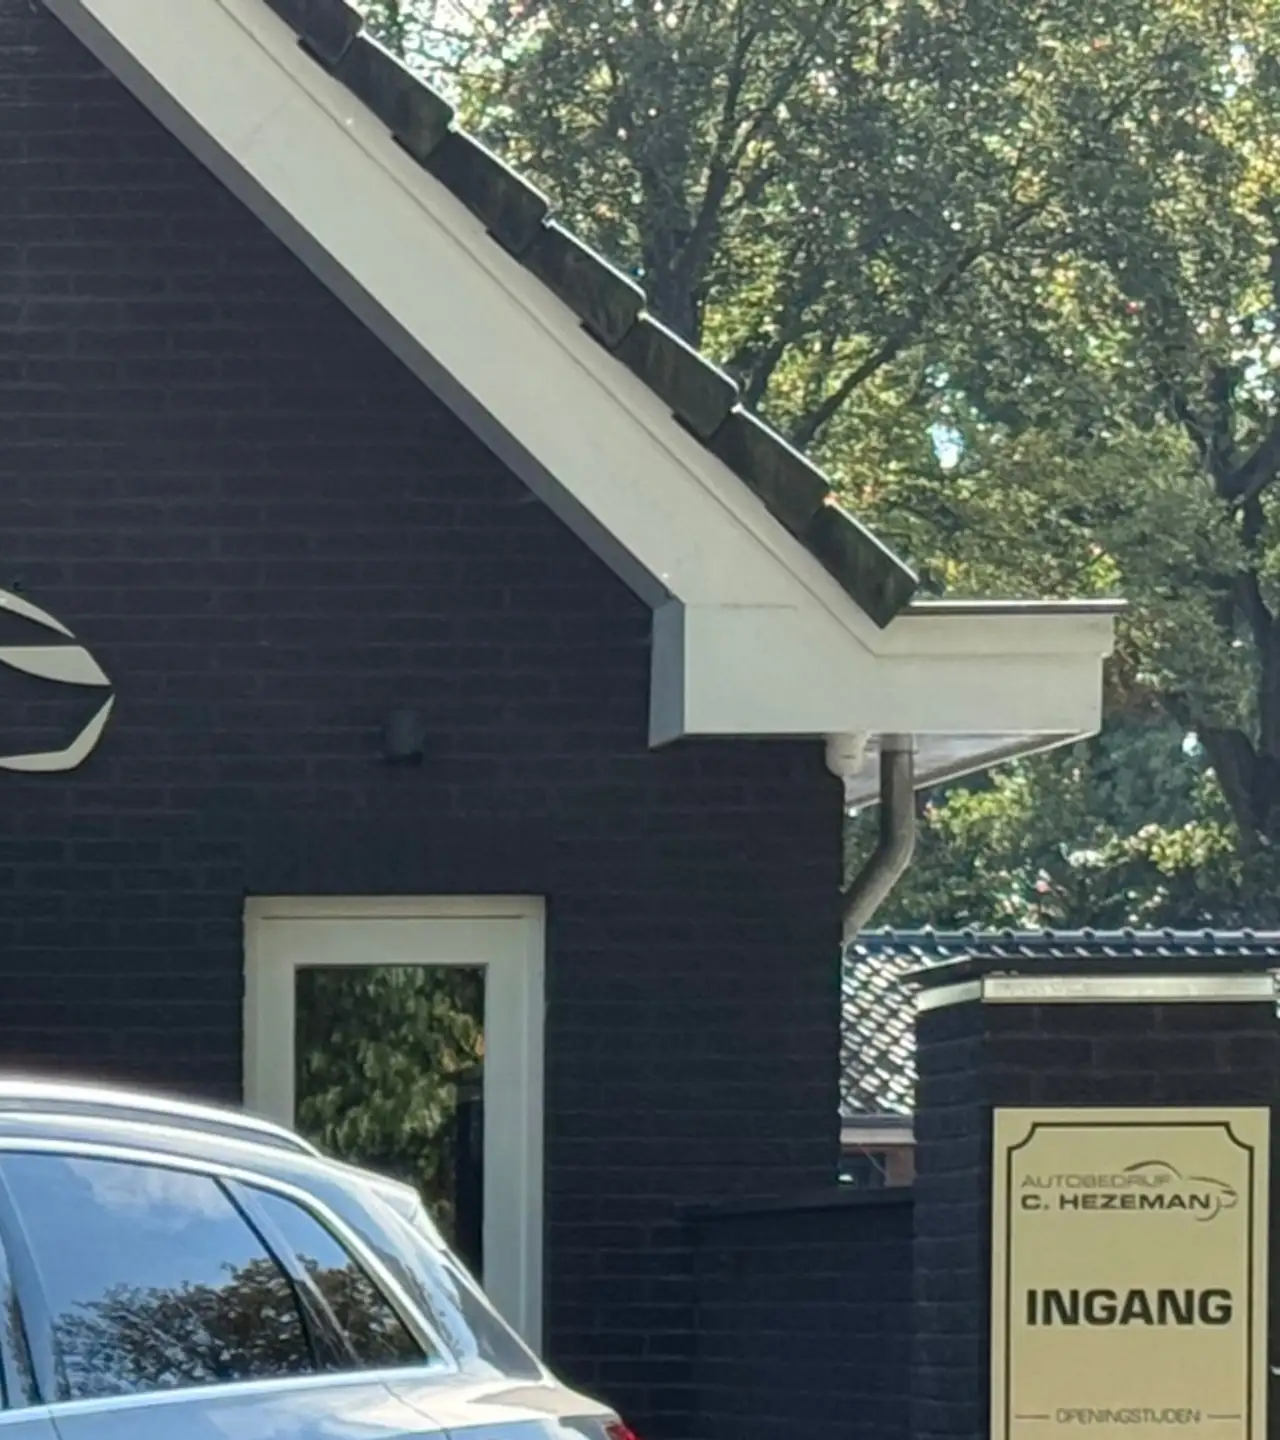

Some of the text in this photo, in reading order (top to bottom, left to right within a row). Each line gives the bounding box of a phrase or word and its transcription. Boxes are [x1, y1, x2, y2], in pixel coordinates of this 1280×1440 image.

[1021, 1174, 1172, 1189] AUTOBEDRIJF
[1021, 1194, 1211, 1210] C. HEZEMAN
[1026, 1288, 1233, 1326] INGANG
[1055, 1408, 1201, 1424] OPENINGSTIJDEN
